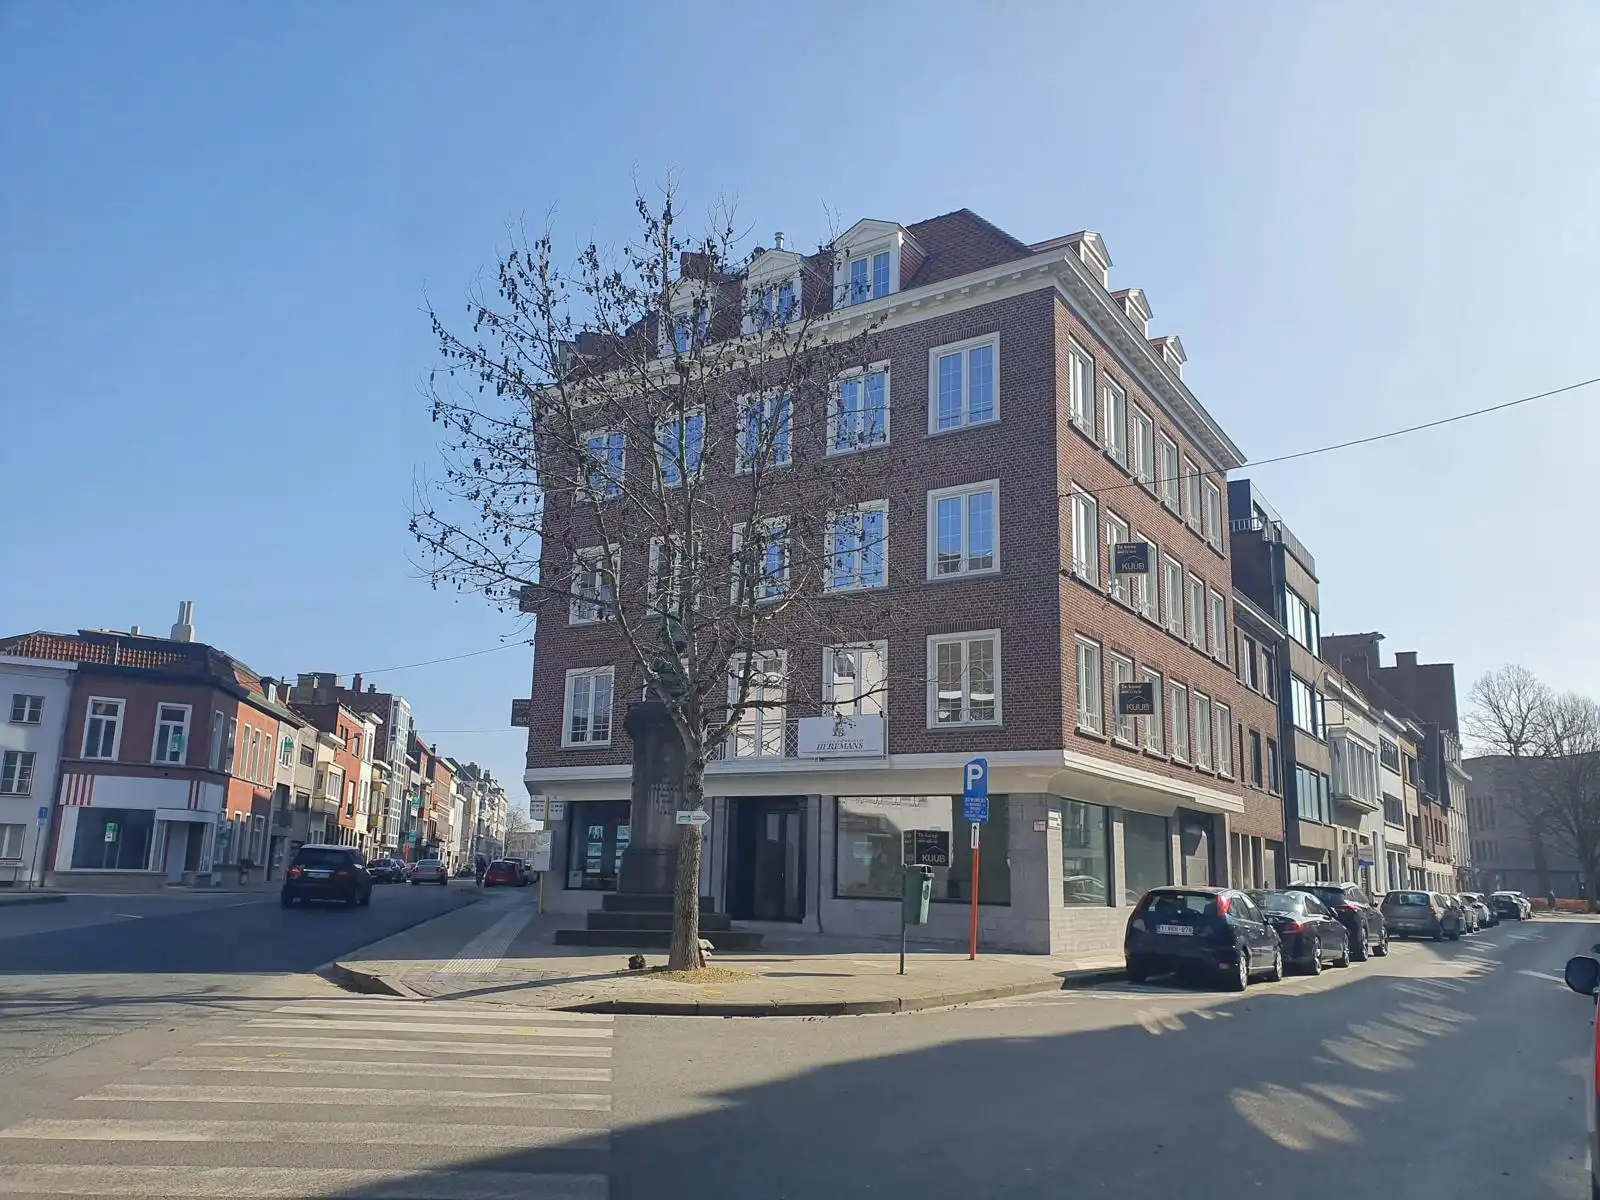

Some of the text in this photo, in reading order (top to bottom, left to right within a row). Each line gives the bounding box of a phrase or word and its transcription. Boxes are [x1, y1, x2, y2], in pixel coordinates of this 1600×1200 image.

[1121, 562, 1145, 570] KUUB
[1126, 703, 1150, 711] KUUB
[967, 764, 983, 791] P
[921, 854, 946, 863] KUUB
